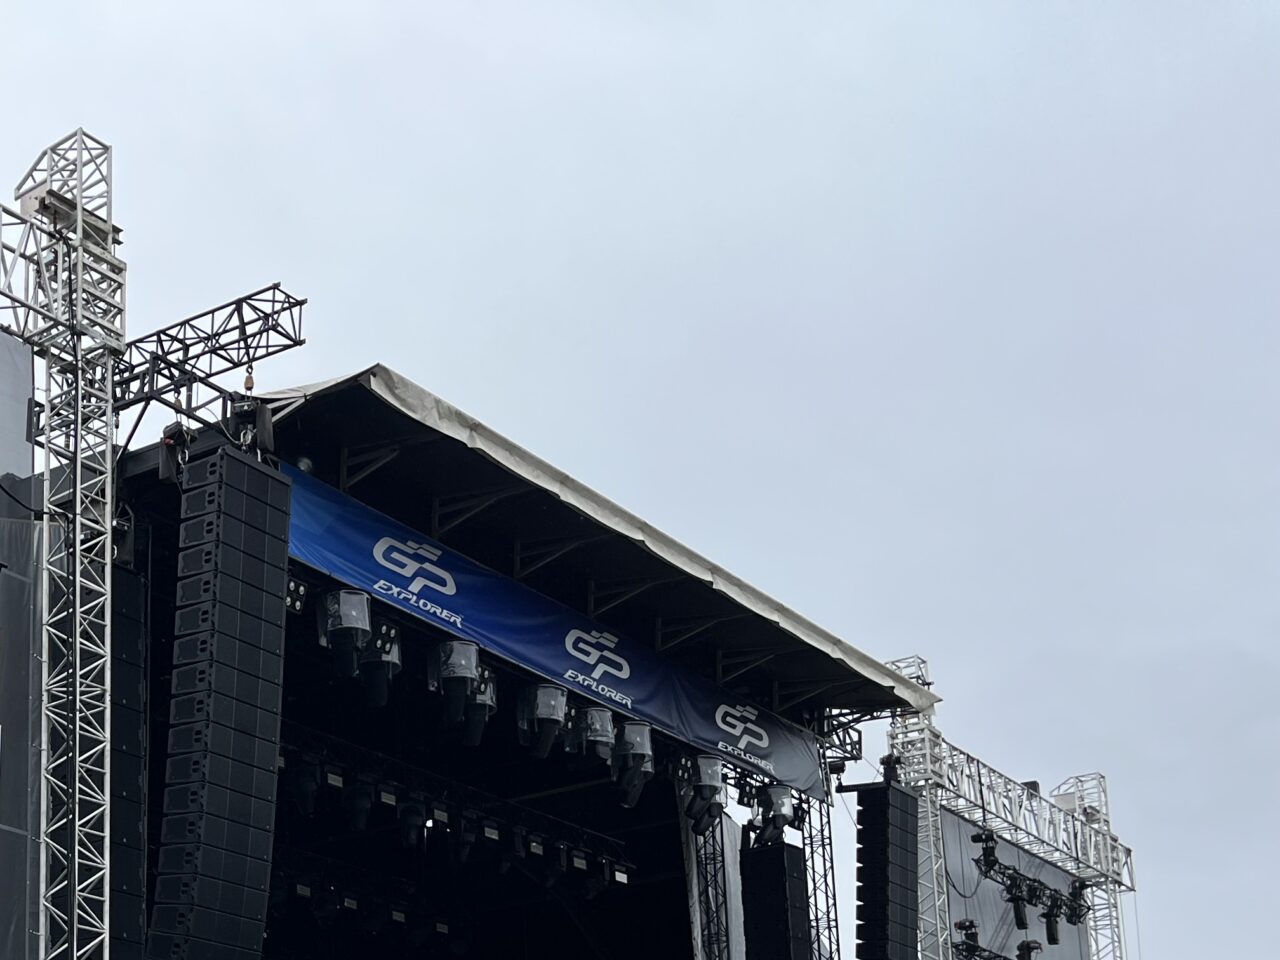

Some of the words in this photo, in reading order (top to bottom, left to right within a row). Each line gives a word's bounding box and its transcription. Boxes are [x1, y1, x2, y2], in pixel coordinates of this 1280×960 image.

[373, 537, 456, 595] GP
[373, 580, 462, 628] EXPLORER
[565, 629, 631, 679] GP
[563, 669, 632, 709] EXPLORER
[717, 741, 775, 774] EXPLORER
